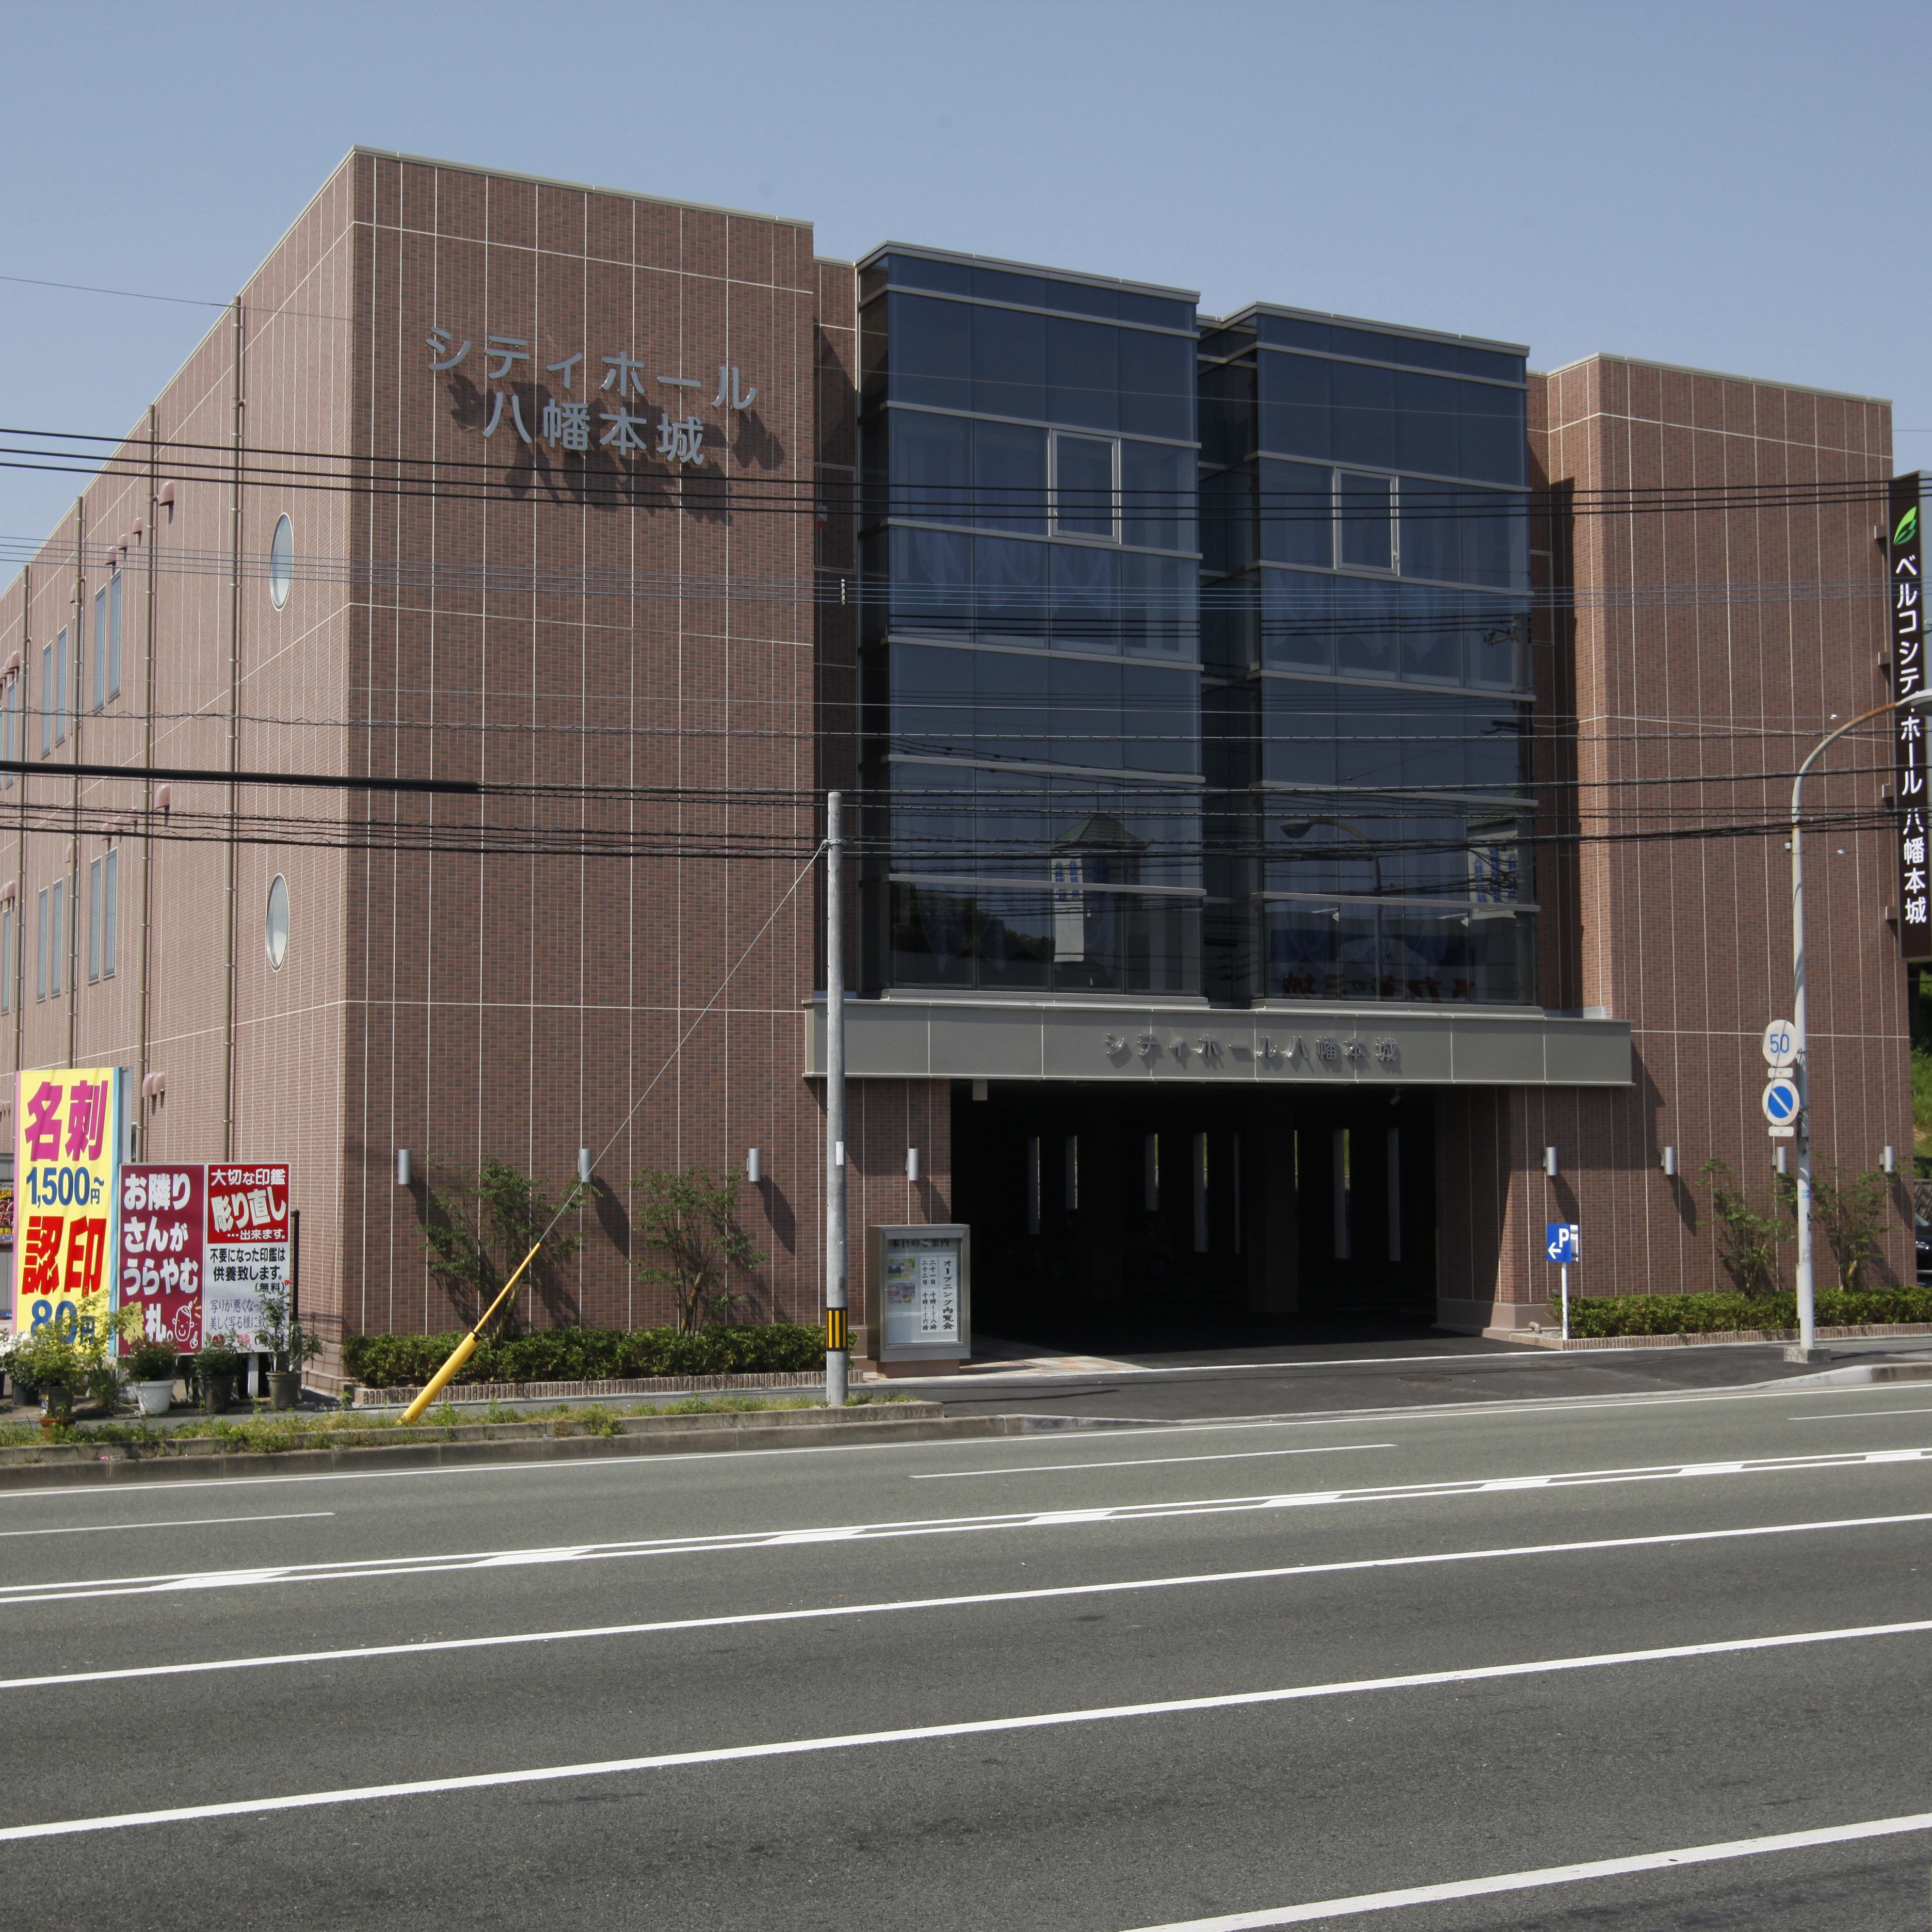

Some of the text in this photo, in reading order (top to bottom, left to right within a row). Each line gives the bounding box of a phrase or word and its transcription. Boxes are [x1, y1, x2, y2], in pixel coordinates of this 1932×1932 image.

[426, 327, 756, 409] シティホール
[483, 392, 704, 464] 八幡本城
[1895, 555, 1926, 924] ベルコシテホール 八幡本城
[1106, 1033, 1396, 1061] シティホール八幡本城
[1770, 1034, 1790, 1053] 50
[25, 1080, 108, 1161] 名刺
[124, 1173, 191, 1211] お隣り
[211, 1168, 286, 1186] 大切な印鑑
[211, 1186, 286, 1233] 彫り直し
[124, 1216, 189, 1253] さんが
[1559, 1228, 1569, 1248] P
[22, 1216, 107, 1297] 認印
[210, 1247, 285, 1263] 不要になった印鑑は
[214, 1265, 282, 1282] 供養致します。
[123, 1257, 199, 1296] うらやむ
